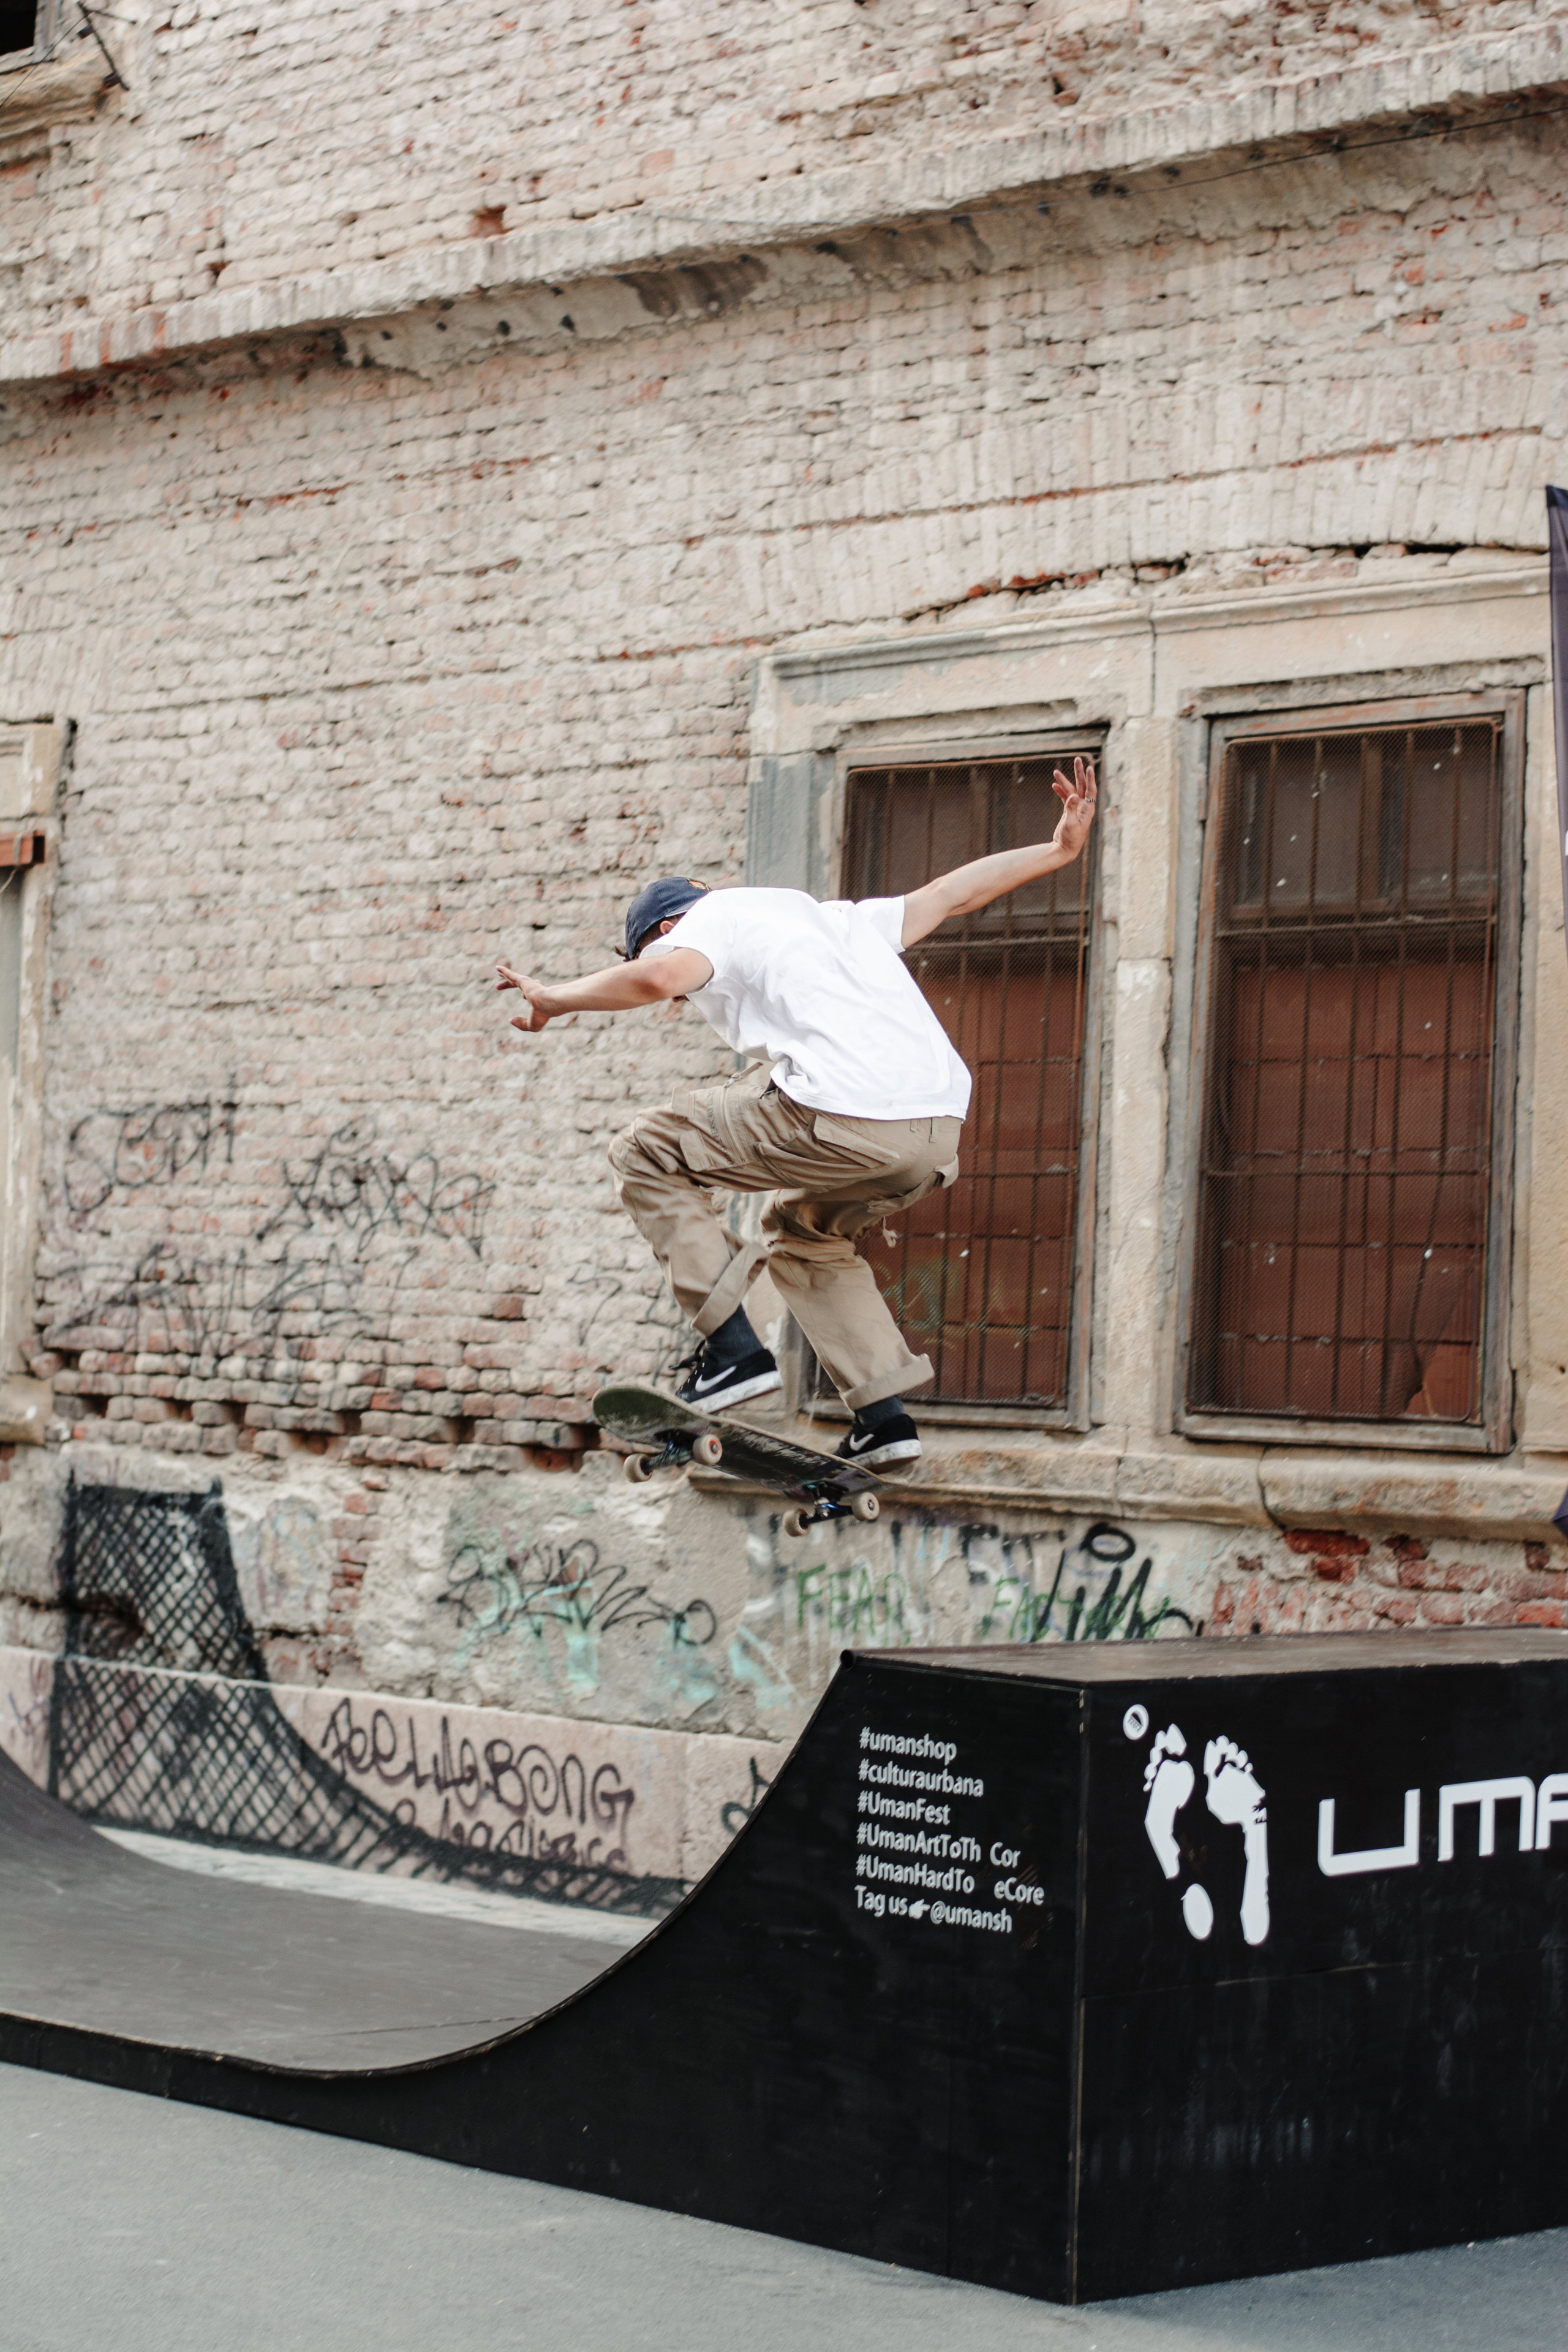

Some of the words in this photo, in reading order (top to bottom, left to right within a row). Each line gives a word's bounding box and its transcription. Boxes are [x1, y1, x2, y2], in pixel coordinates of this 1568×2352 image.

[859, 1727, 957, 1766] #umanshop
[858, 1758, 984, 1797] #culturaurbana
[857, 1790, 951, 1825] #UmanFest
[854, 1885, 886, 1917] Tag
[888, 1896, 908, 1915] us
[930, 1901, 1012, 1933] @umansh
